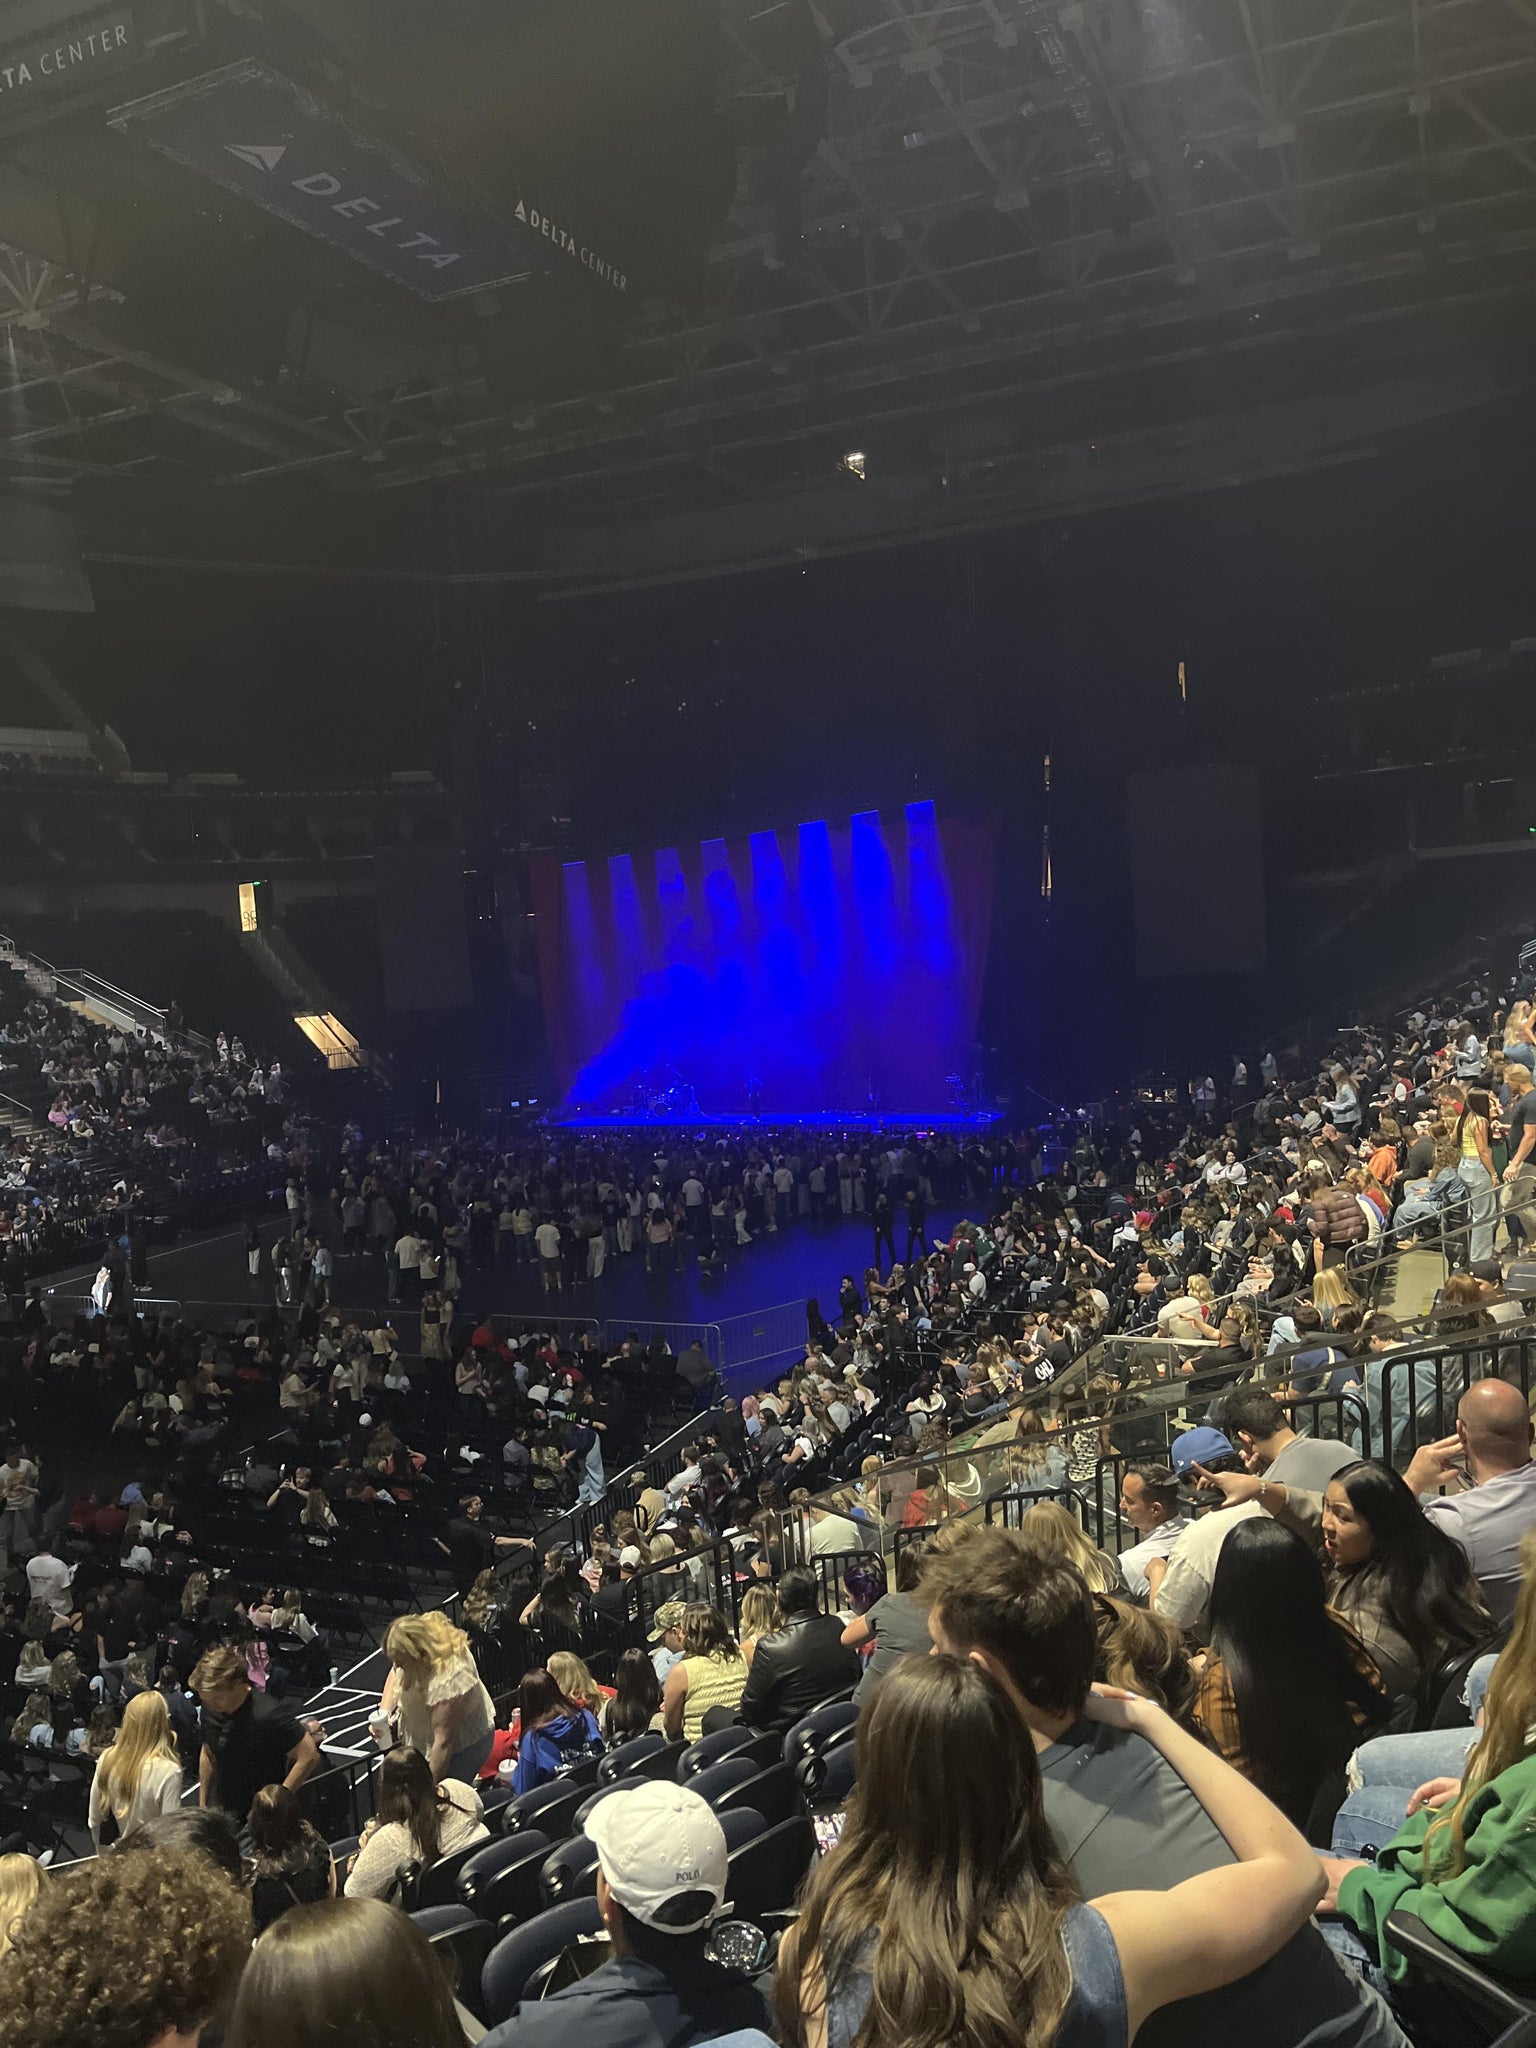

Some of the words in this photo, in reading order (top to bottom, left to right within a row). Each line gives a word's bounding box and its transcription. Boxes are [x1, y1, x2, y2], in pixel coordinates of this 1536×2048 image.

[0, 63, 32, 93] TA
[40, 25, 127, 74] CENTER
[292, 172, 461, 268] DELTA
[530, 209, 576, 256] DELTA
[580, 247, 626, 292] CENTER
[676, 1869, 700, 1882] POLO
